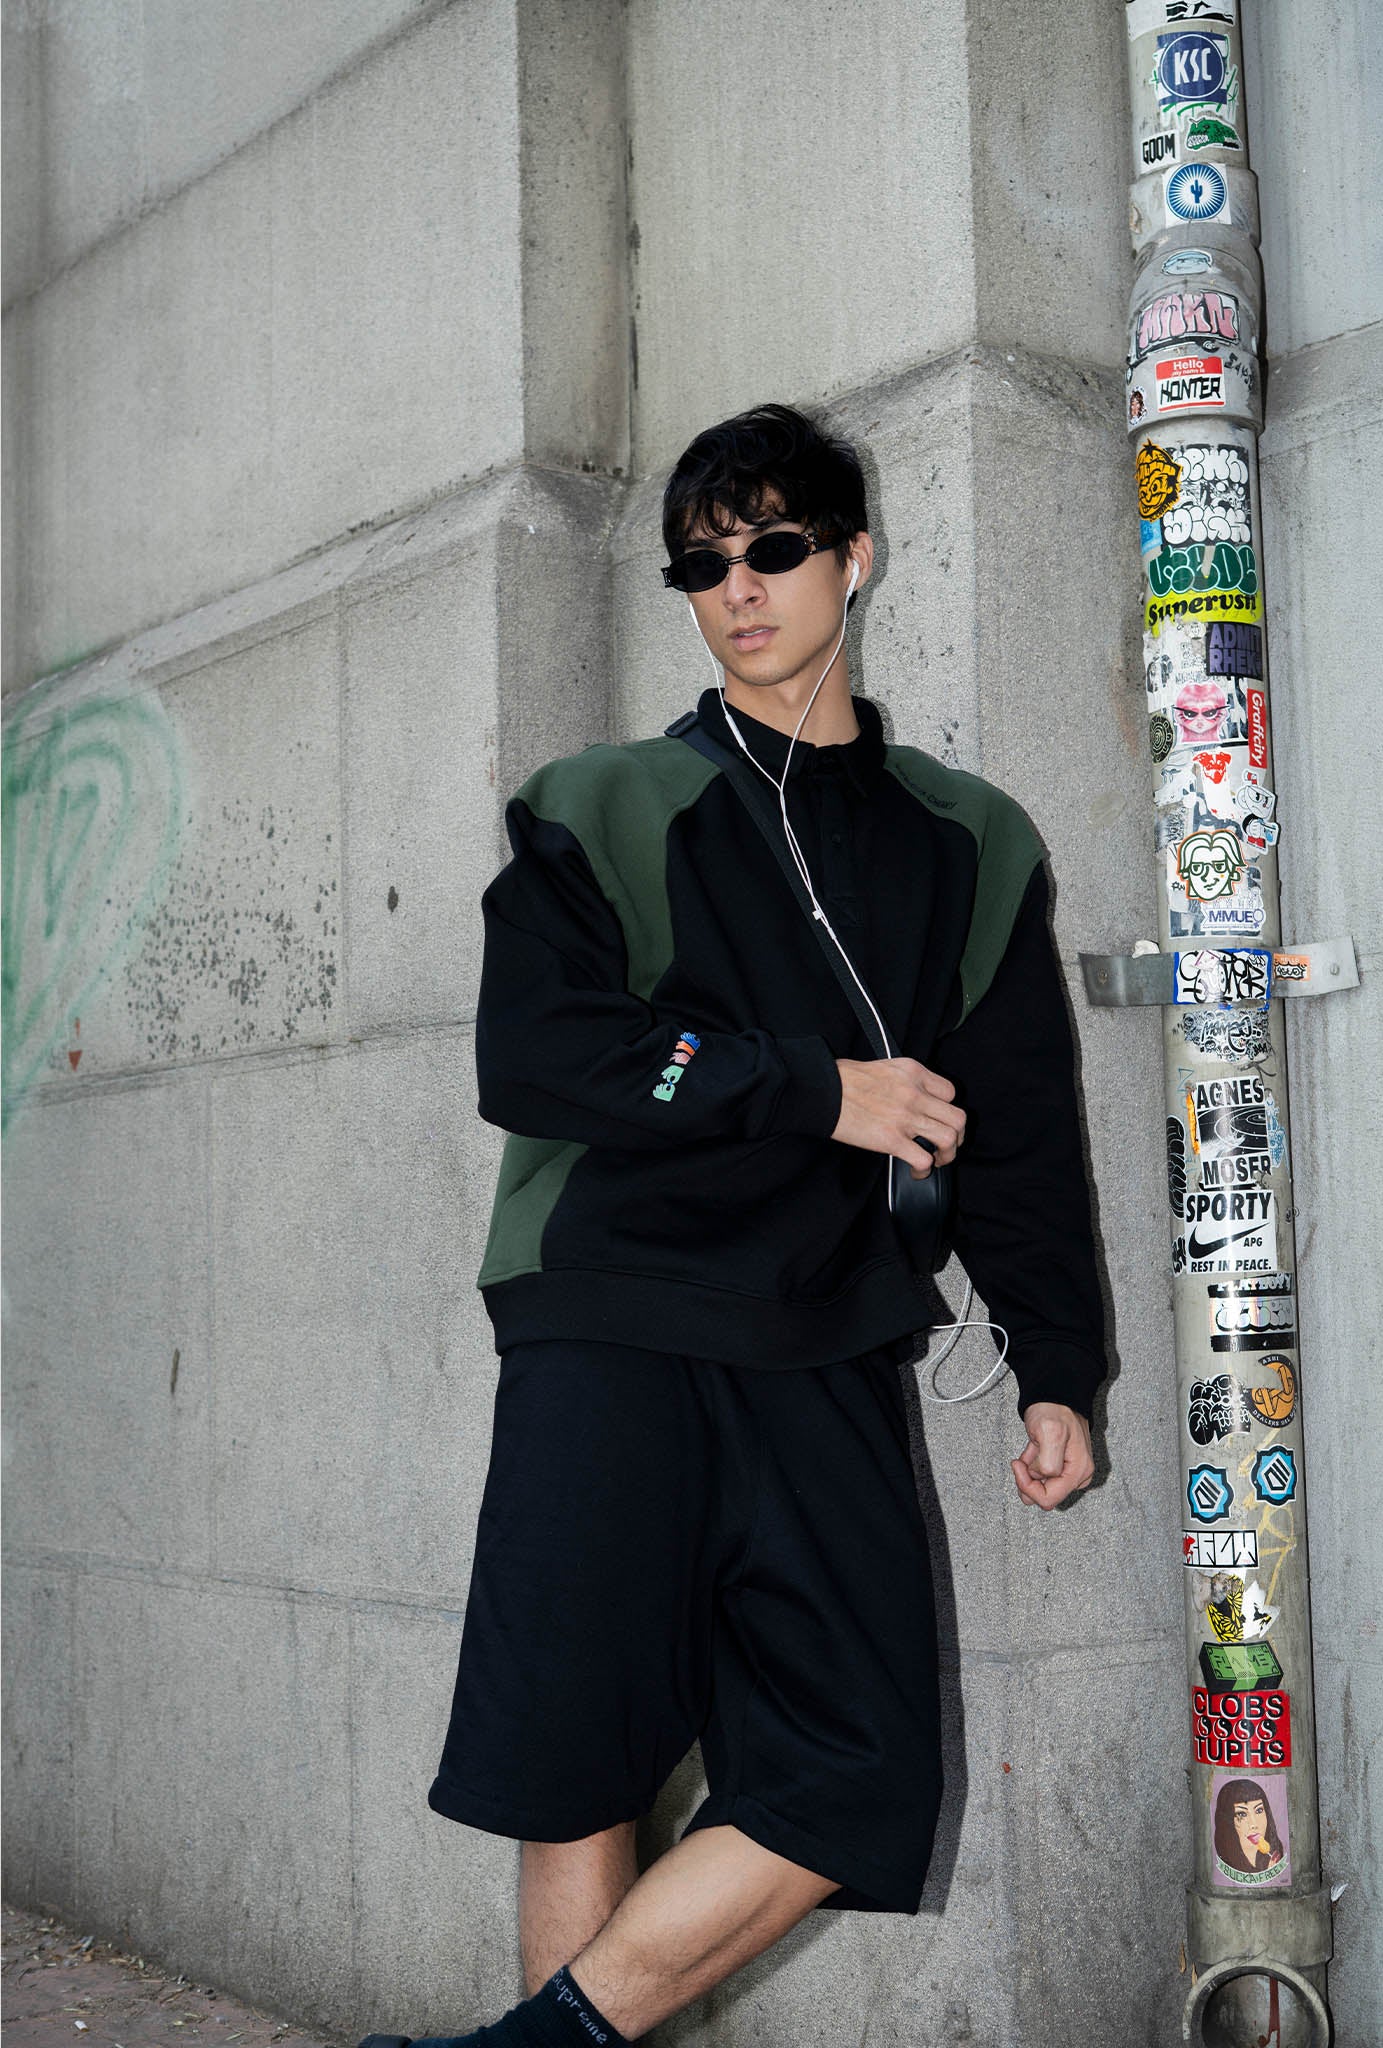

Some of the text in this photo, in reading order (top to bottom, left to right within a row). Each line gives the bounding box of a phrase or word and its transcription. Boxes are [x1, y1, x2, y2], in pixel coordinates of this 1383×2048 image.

[1175, 48, 1212, 85] KSC
[1173, 360, 1204, 370] Hello
[1197, 1078, 1265, 1109] AGNES
[1186, 1192, 1272, 1223] SPORTY
[1243, 1237, 1263, 1247] APG
[1191, 1259, 1272, 1273] REST IN PEACE.
[1194, 1735, 1285, 1766] TUPHS
[552, 1968, 608, 2044] Supreme
